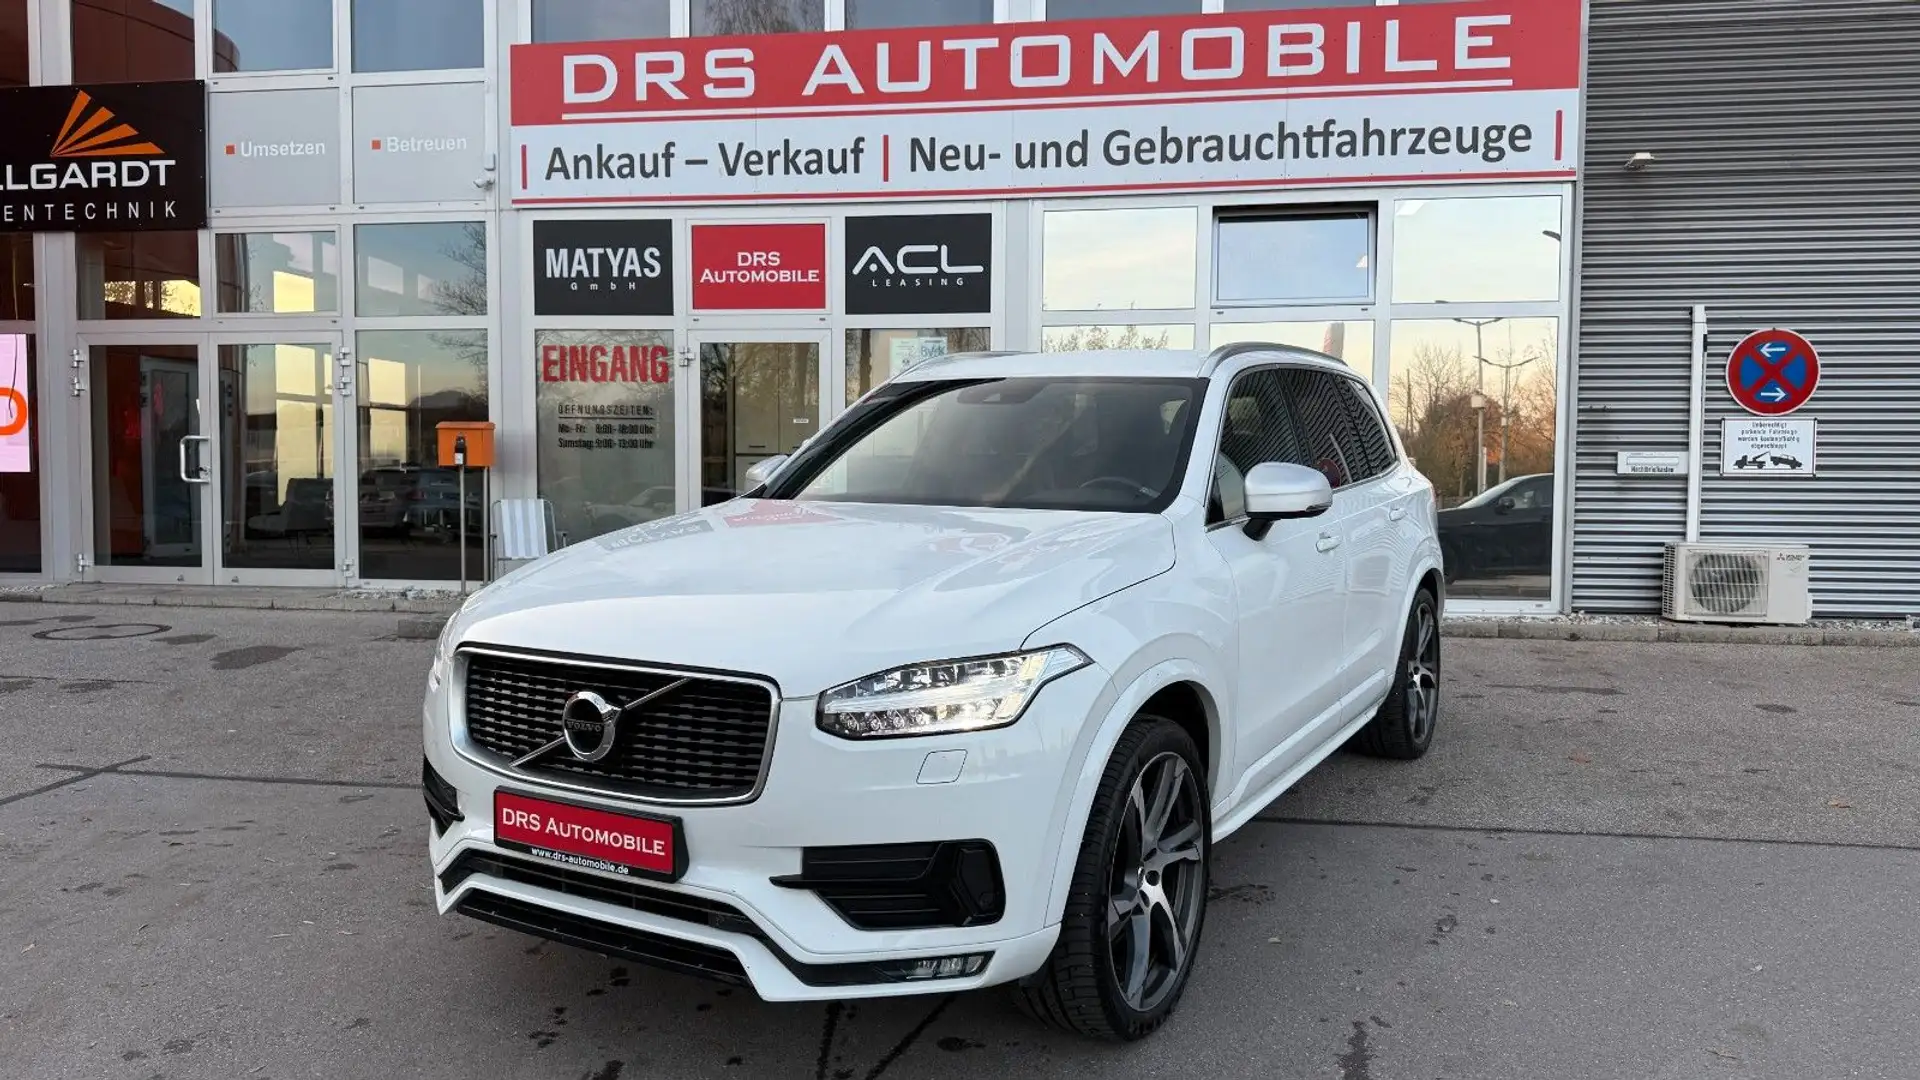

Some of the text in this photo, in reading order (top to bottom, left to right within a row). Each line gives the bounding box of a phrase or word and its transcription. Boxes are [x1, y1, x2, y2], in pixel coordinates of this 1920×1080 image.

[563, 14, 1512, 104] DRS AUTOMOBILE
[240, 140, 326, 158] Umsetzen
[386, 136, 467, 153] Betreuen
[545, 142, 676, 181] Ankauf
[718, 137, 865, 177] Verkauf
[910, 117, 1532, 173] Neu- und Gebrauchtfahrzeuge
[0, 159, 176, 191] LGARDT
[3, 200, 176, 222] ENTECHNIK
[545, 247, 661, 279] MATYAS
[737, 251, 781, 267] DRS
[852, 244, 984, 275] ACL
[700, 268, 820, 284] AUTOMOBILE
[872, 277, 964, 287] LEASING
[542, 345, 669, 383] EINGANG
[502, 807, 666, 857] DRS AUTOMOBILE
[531, 847, 630, 876] www.drs-automobile.de
